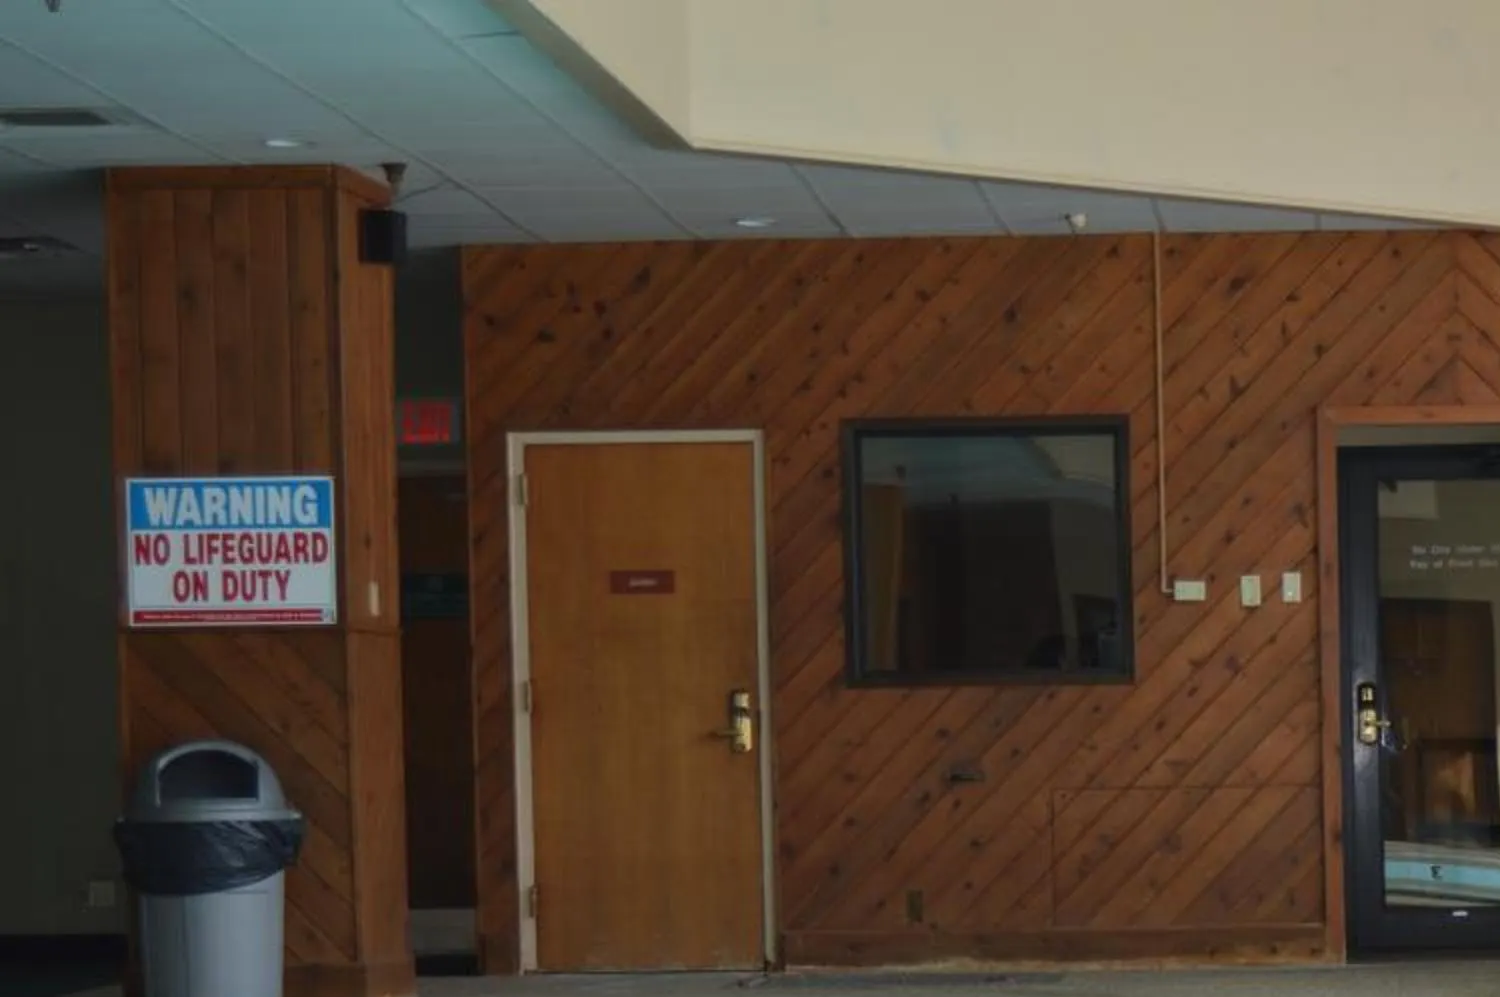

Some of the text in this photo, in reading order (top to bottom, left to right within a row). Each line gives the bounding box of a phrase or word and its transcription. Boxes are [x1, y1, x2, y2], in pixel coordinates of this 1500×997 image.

[143, 484, 319, 526] WARNING
[134, 531, 329, 565] NO LIFEGUARD
[172, 569, 291, 602] ON DUTY
